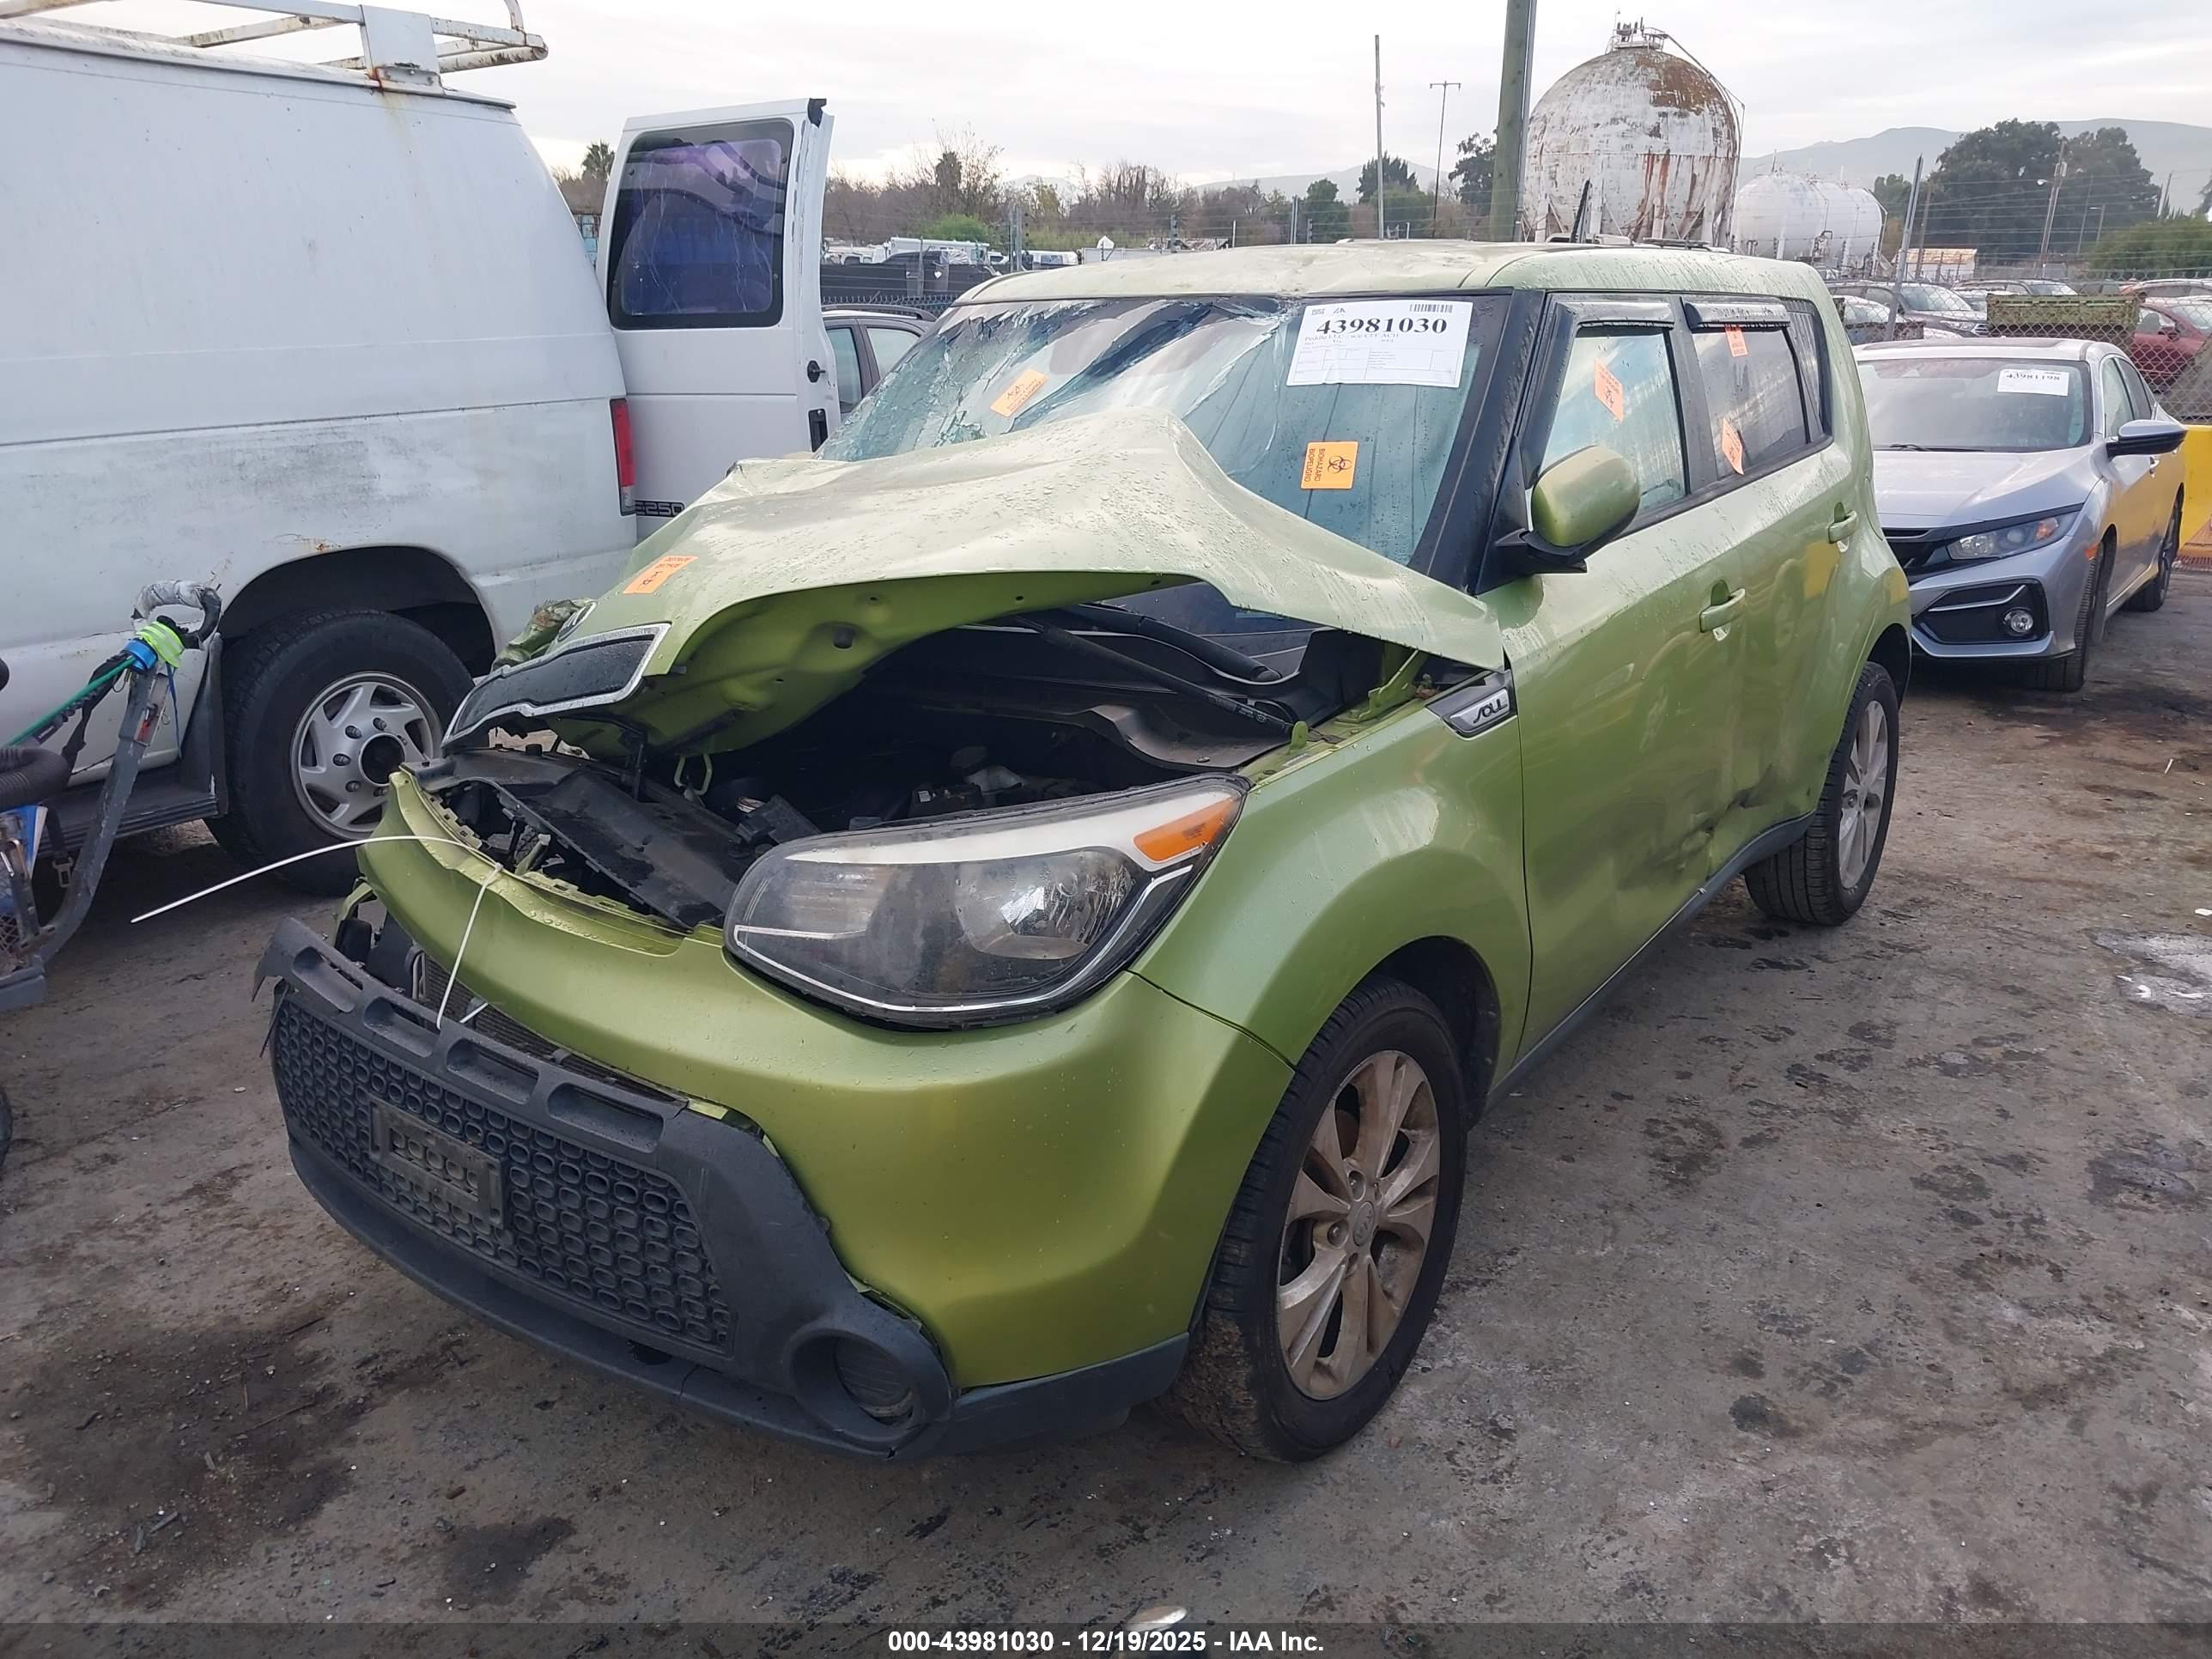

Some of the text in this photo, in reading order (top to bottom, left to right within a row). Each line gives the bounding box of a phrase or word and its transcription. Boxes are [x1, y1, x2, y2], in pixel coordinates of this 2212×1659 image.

[1316, 317, 1449, 335] 43981030
[1304, 448, 1316, 483] BIOPELIGRO
[1314, 448, 1326, 482] BIOHAZARD
[1473, 698, 1509, 724] SOUL
